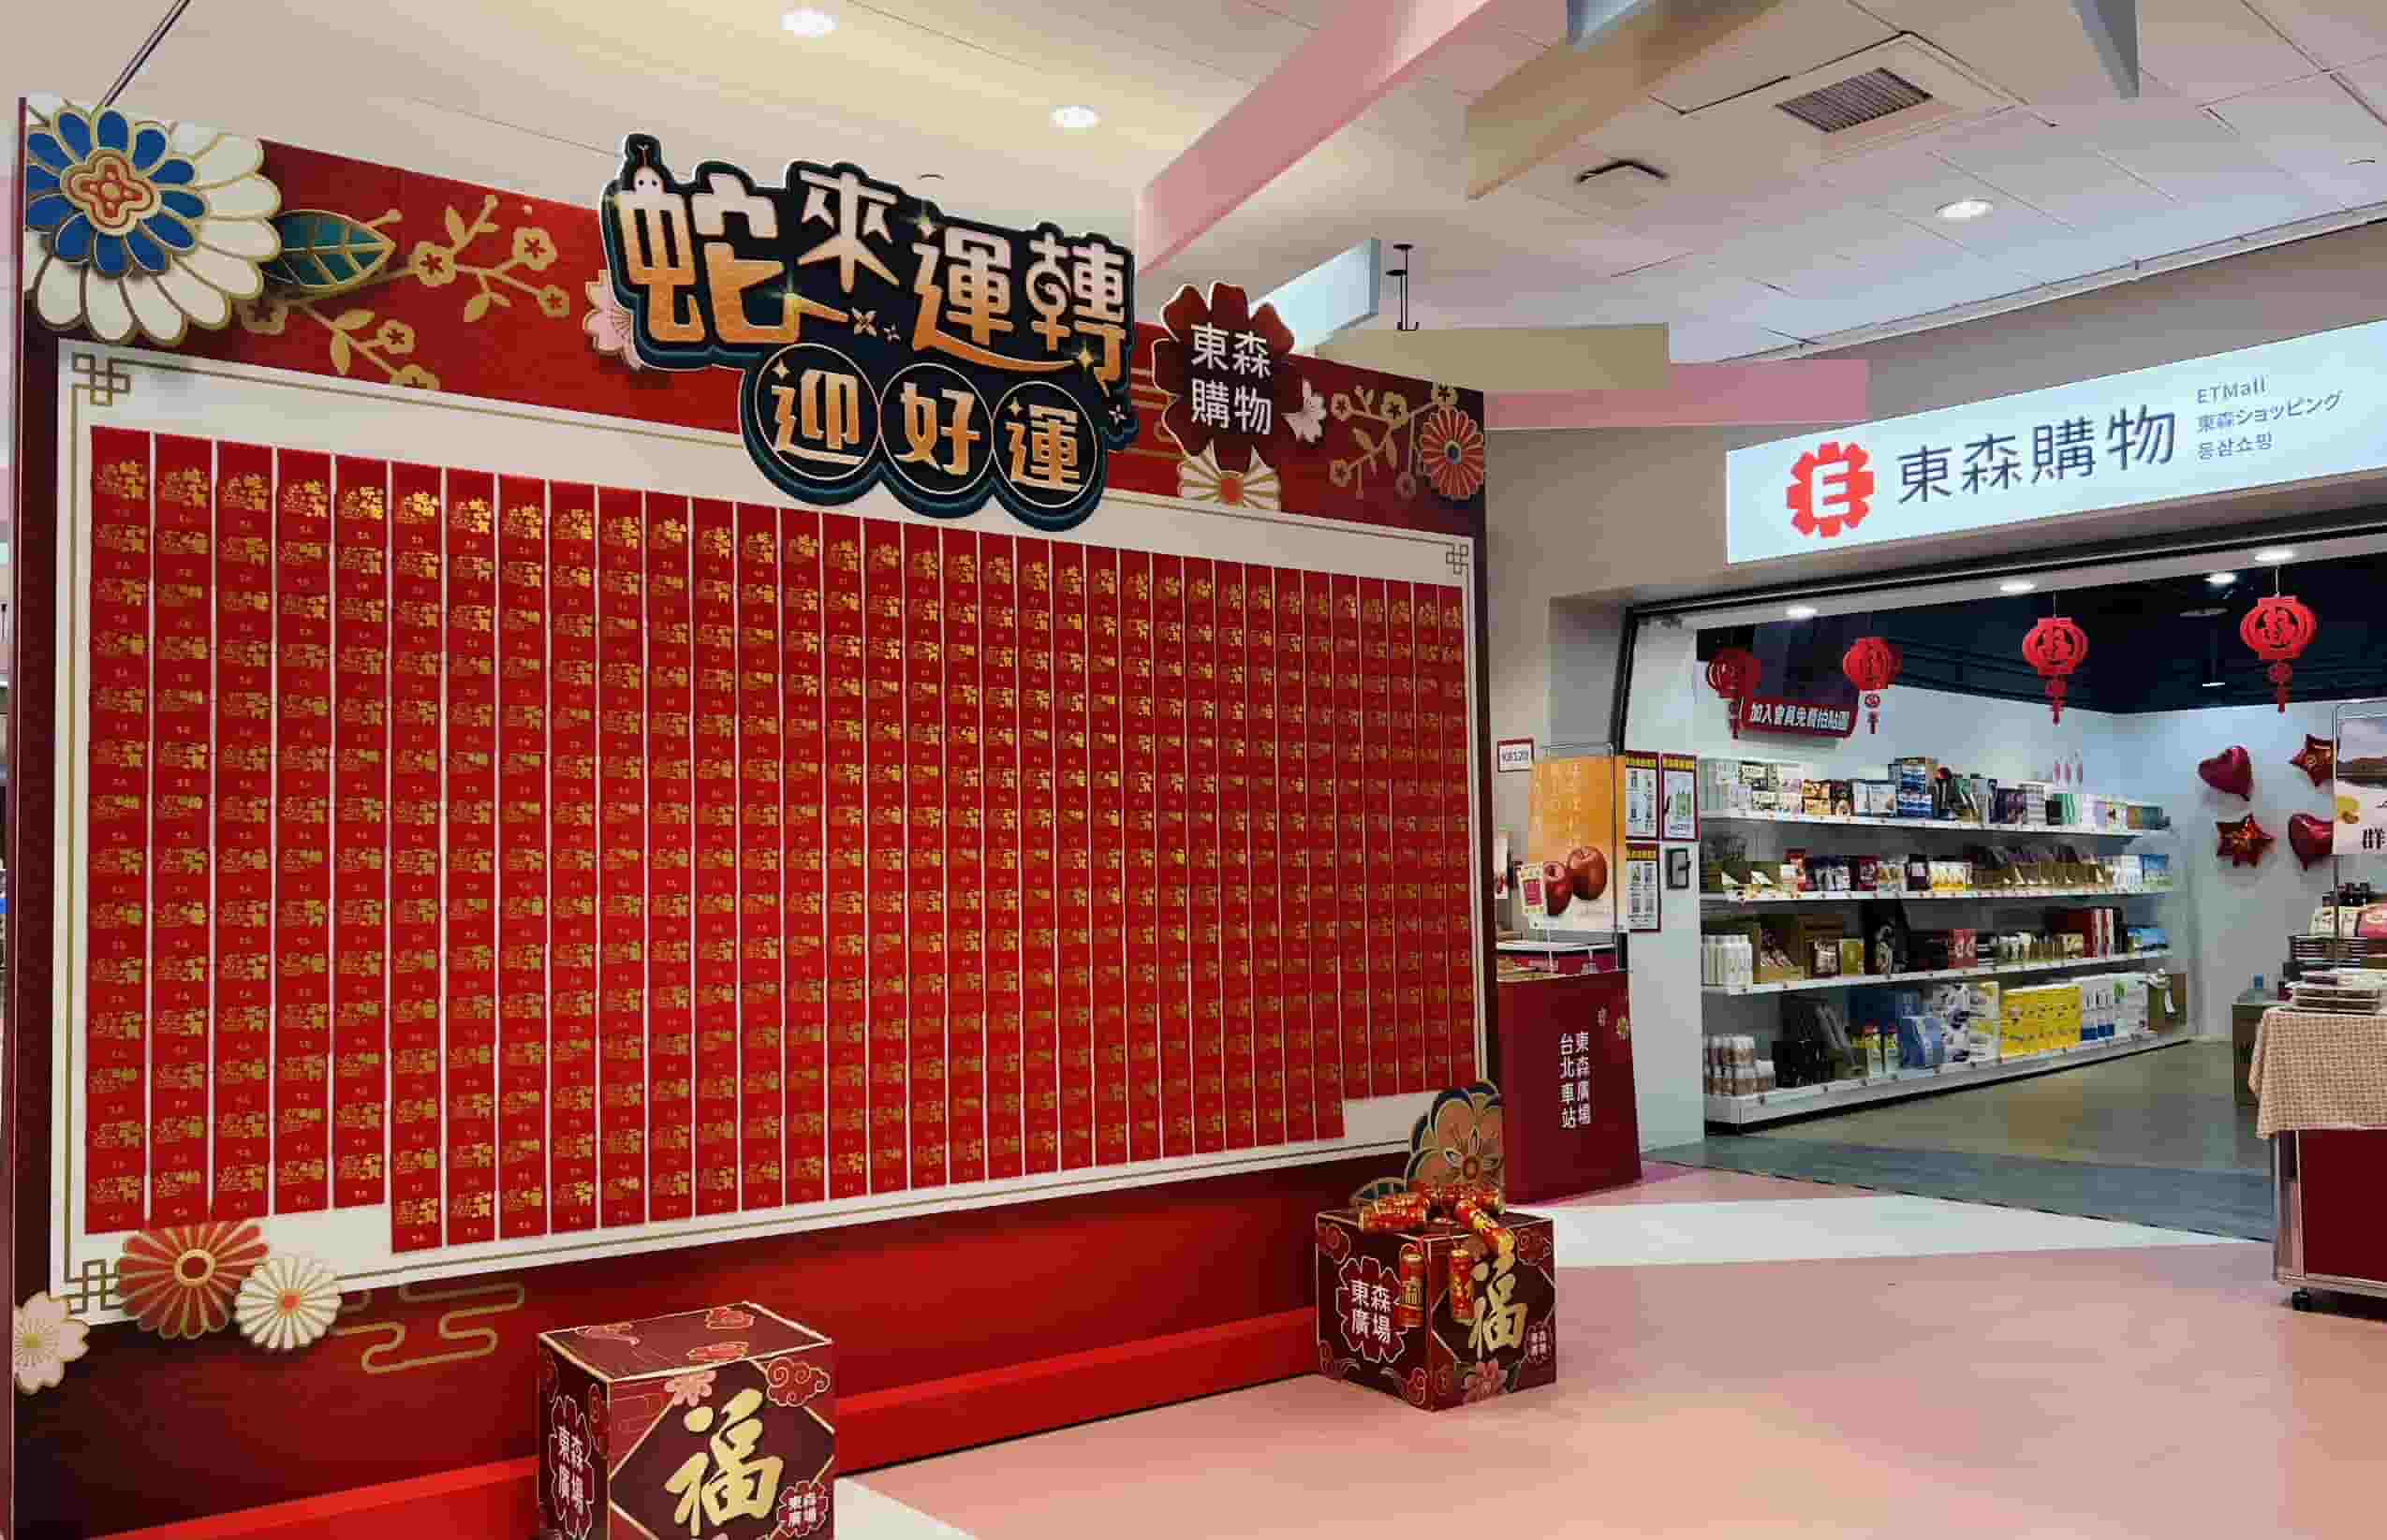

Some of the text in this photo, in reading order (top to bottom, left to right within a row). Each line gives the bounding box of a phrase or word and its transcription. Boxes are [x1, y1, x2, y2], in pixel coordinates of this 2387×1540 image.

[615, 165, 1129, 389] 蛇來運轉
[1190, 323, 1273, 378] 東森
[1190, 379, 1274, 437] 購物
[2197, 374, 2266, 403] ETMall
[2197, 389, 2343, 433] 東森ショッピング
[770, 371, 1082, 491] 迎好運
[1896, 404, 2176, 504] 東森購物
[1559, 1033, 1575, 1129] 台北車站
[1350, 1280, 1391, 1313] 東森
[1351, 1309, 1391, 1342] 廣場
[664, 1388, 785, 1536] 福
